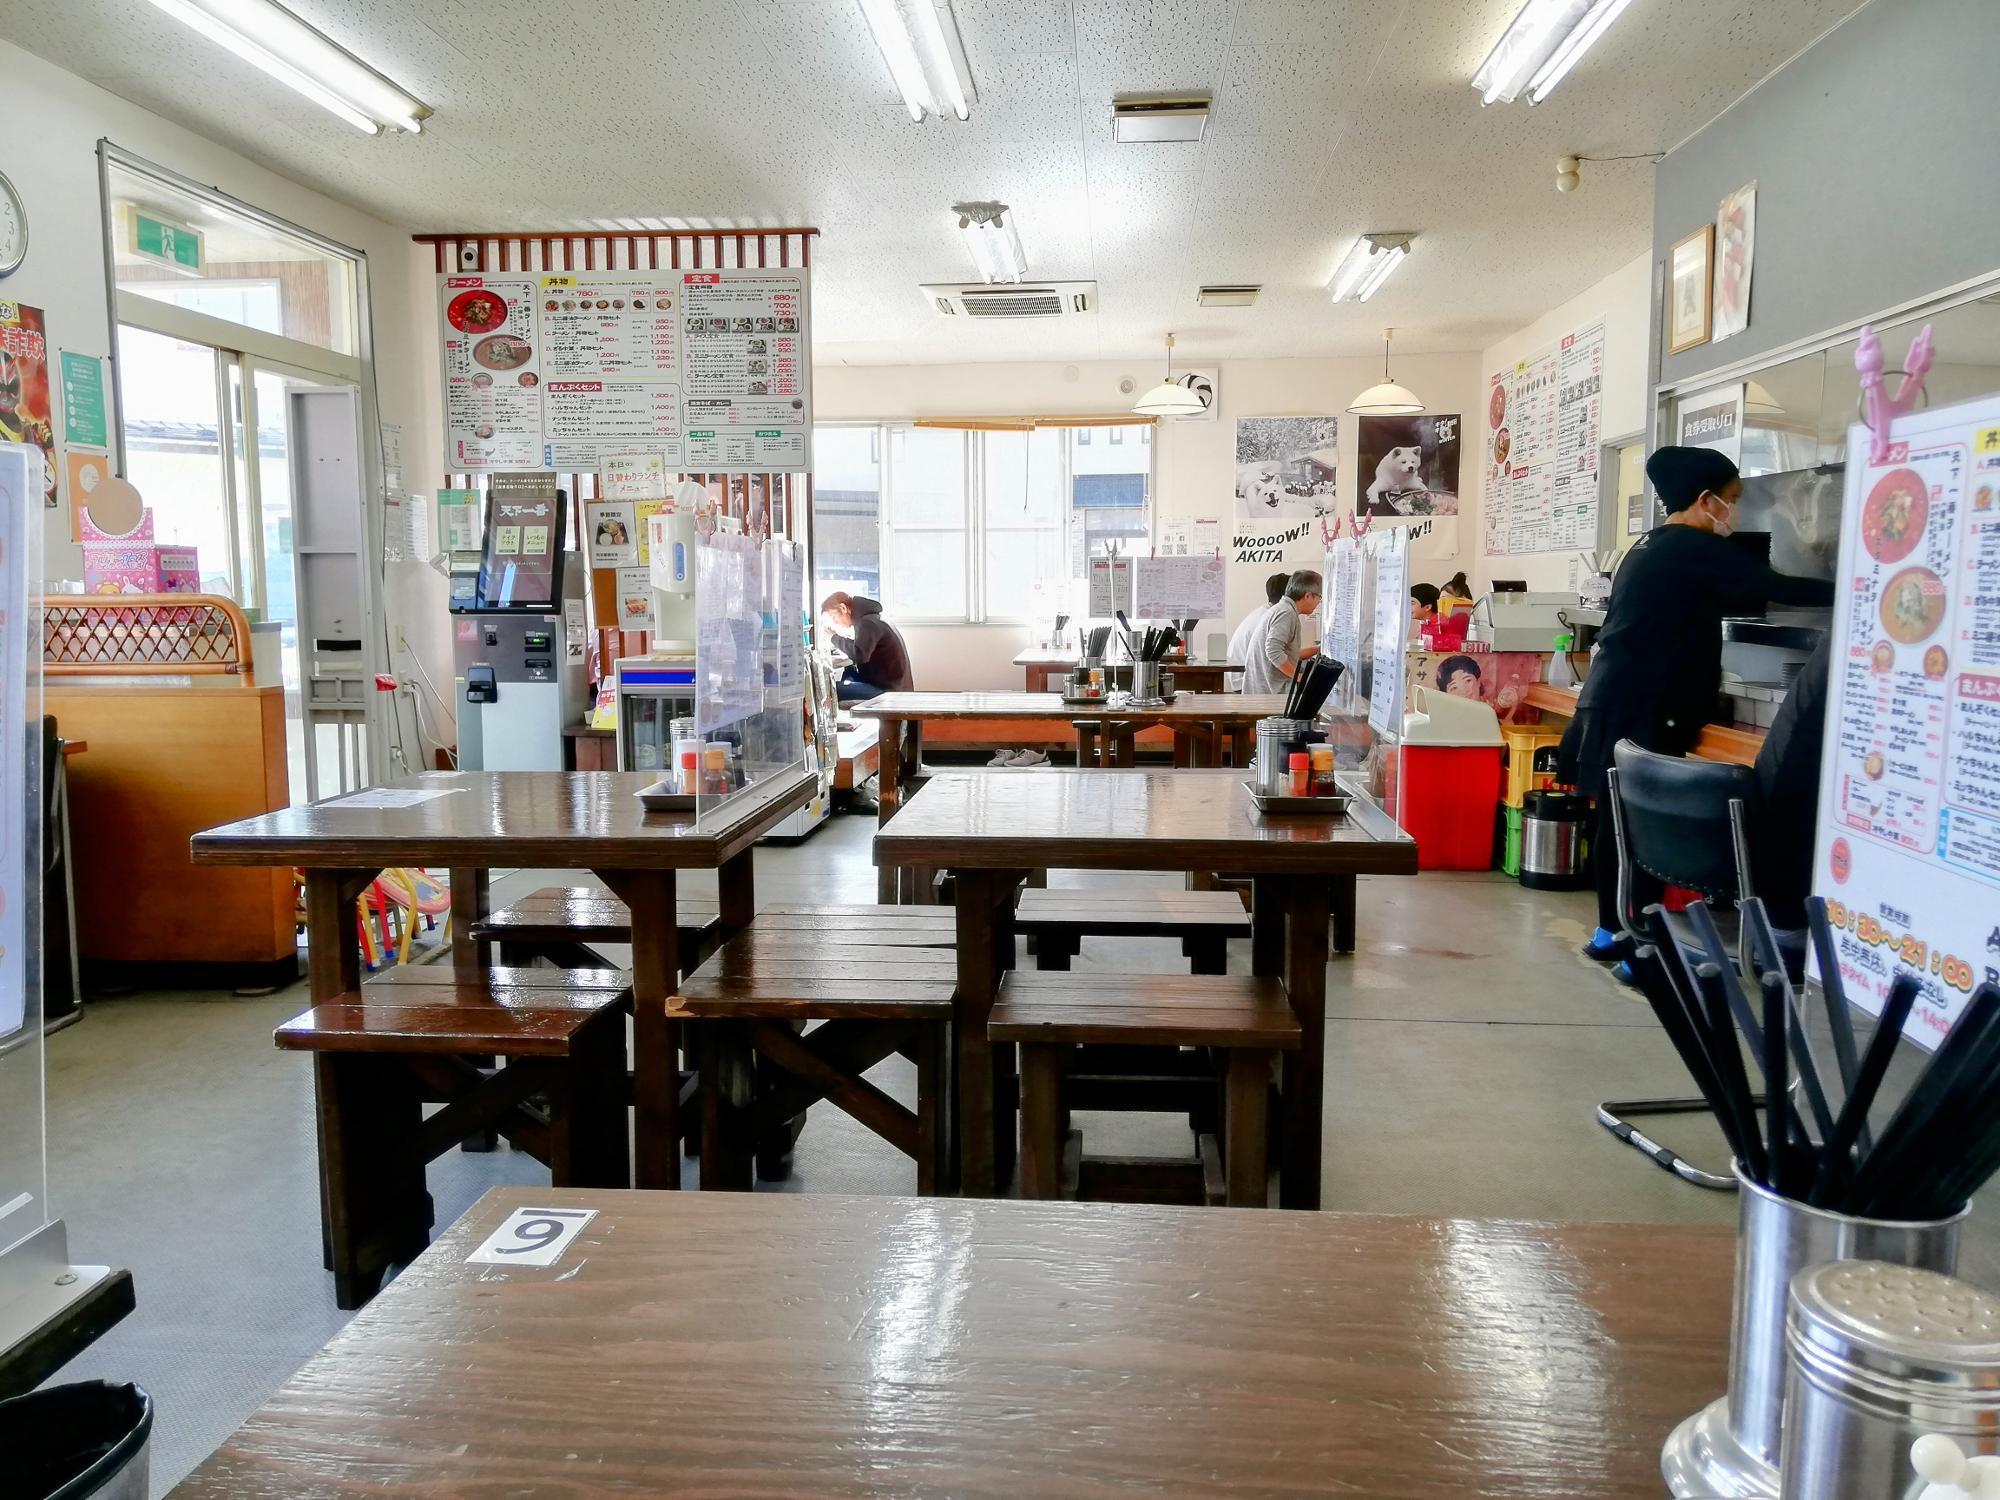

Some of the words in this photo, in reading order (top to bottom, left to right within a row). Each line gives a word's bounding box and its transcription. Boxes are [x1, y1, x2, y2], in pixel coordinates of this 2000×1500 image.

[9, 221, 15, 235] 3
[1684, 413, 1733, 438] 食券受取り口
[608, 461, 633, 469] 本日の
[499, 503, 550, 517] 天下一番
[1234, 549, 1283, 563] AKITA
